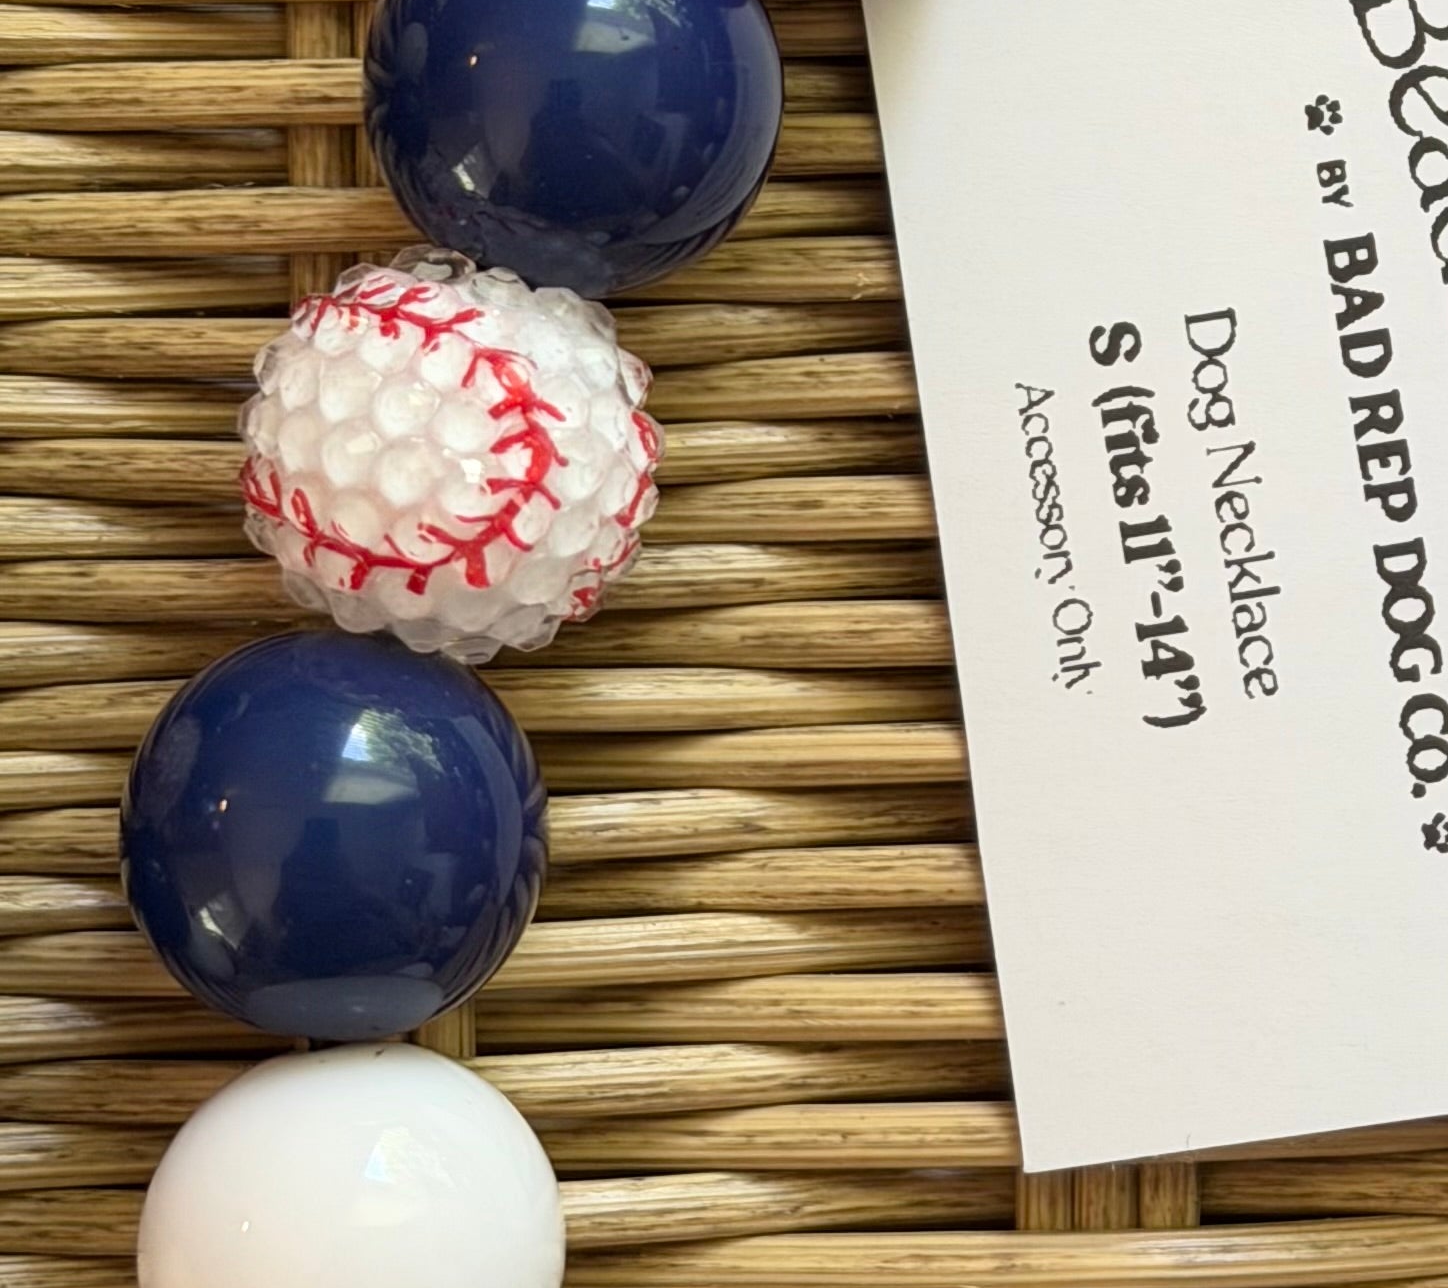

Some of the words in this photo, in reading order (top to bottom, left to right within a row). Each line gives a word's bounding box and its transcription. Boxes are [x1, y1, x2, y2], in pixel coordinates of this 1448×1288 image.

[1315, 158, 1355, 209] BY
[1087, 320, 1144, 368] S
[1183, 306, 1239, 433] Dog
[1321, 231, 1394, 380] BAD
[1090, 384, 1161, 510] (fits
[1347, 387, 1419, 524] REP
[1205, 439, 1282, 701] Necklace
[1371, 535, 1445, 684] DOG
